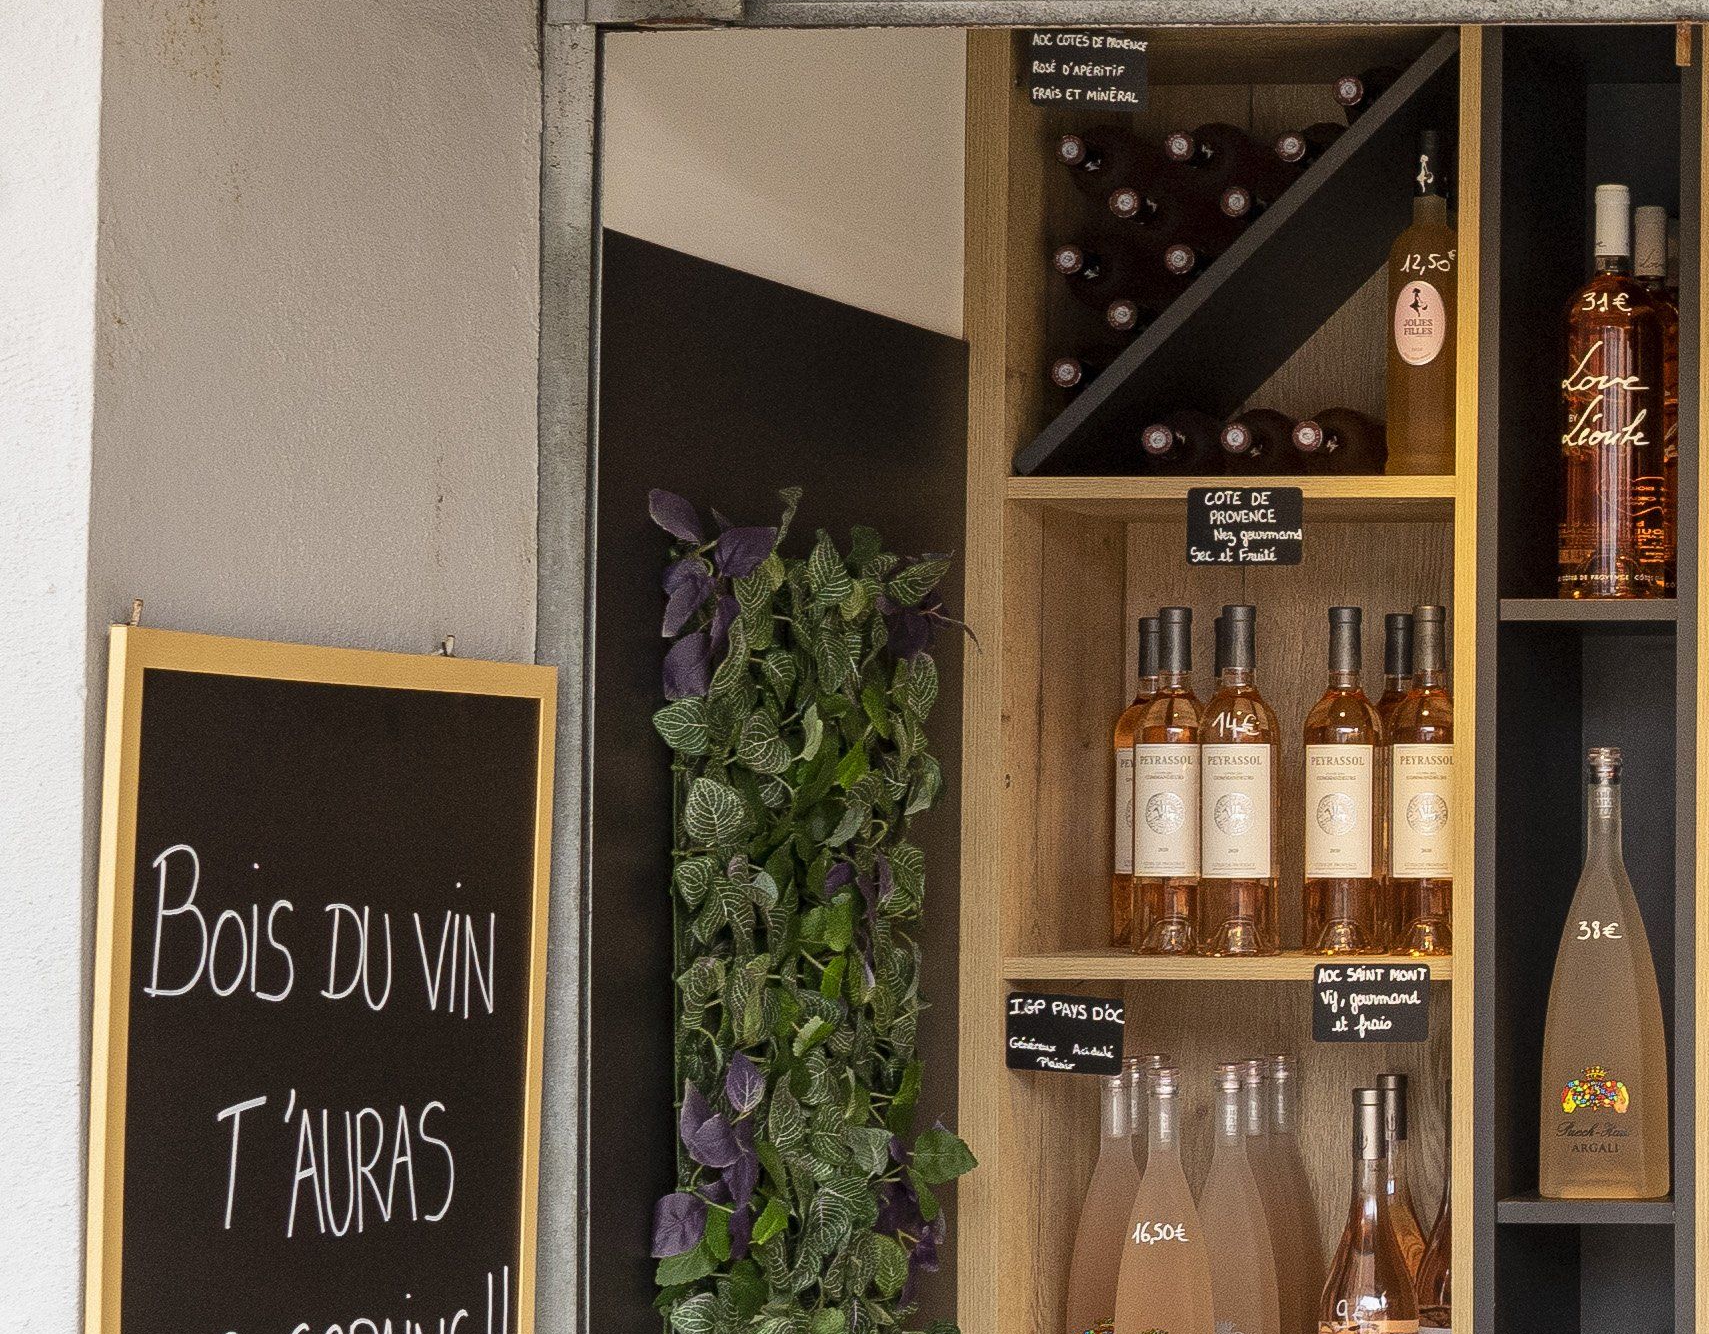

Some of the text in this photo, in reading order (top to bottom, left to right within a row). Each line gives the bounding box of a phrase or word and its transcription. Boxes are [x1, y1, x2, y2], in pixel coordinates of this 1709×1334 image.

[1032, 33, 1053, 46] AOC
[1092, 36, 1104, 48] DE
[1107, 37, 1148, 52] PROVENCE
[1066, 88, 1082, 101] ET
[1581, 291, 1631, 313] 31€
[1403, 318, 1433, 327] JOLIES
[1403, 327, 1433, 336] FILLES
[1561, 340, 1650, 391] Love
[1204, 491, 1272, 506] COTE DE
[1209, 509, 1277, 525] PROVENCE
[1190, 546, 1278, 563] Sec et Fruité
[1211, 711, 1260, 739] 14€
[1139, 755, 1193, 766] PEYRASSOL
[1207, 755, 1263, 766] PEYRASSOL
[1310, 756, 1365, 766] PEYRASSOL
[1576, 921, 1623, 941] 38€
[321, 903, 392, 1011] DU
[1317, 968, 1343, 985] AOC
[1389, 967, 1428, 982] MONT
[1349, 989, 1422, 1014] gourmand
[1009, 998, 1125, 1025] IGP PAYS D'OC
[1331, 1016, 1394, 1034] et frais
[1571, 1142, 1620, 1153] ARGALI
[1131, 1220, 1190, 1246] 16,50€
